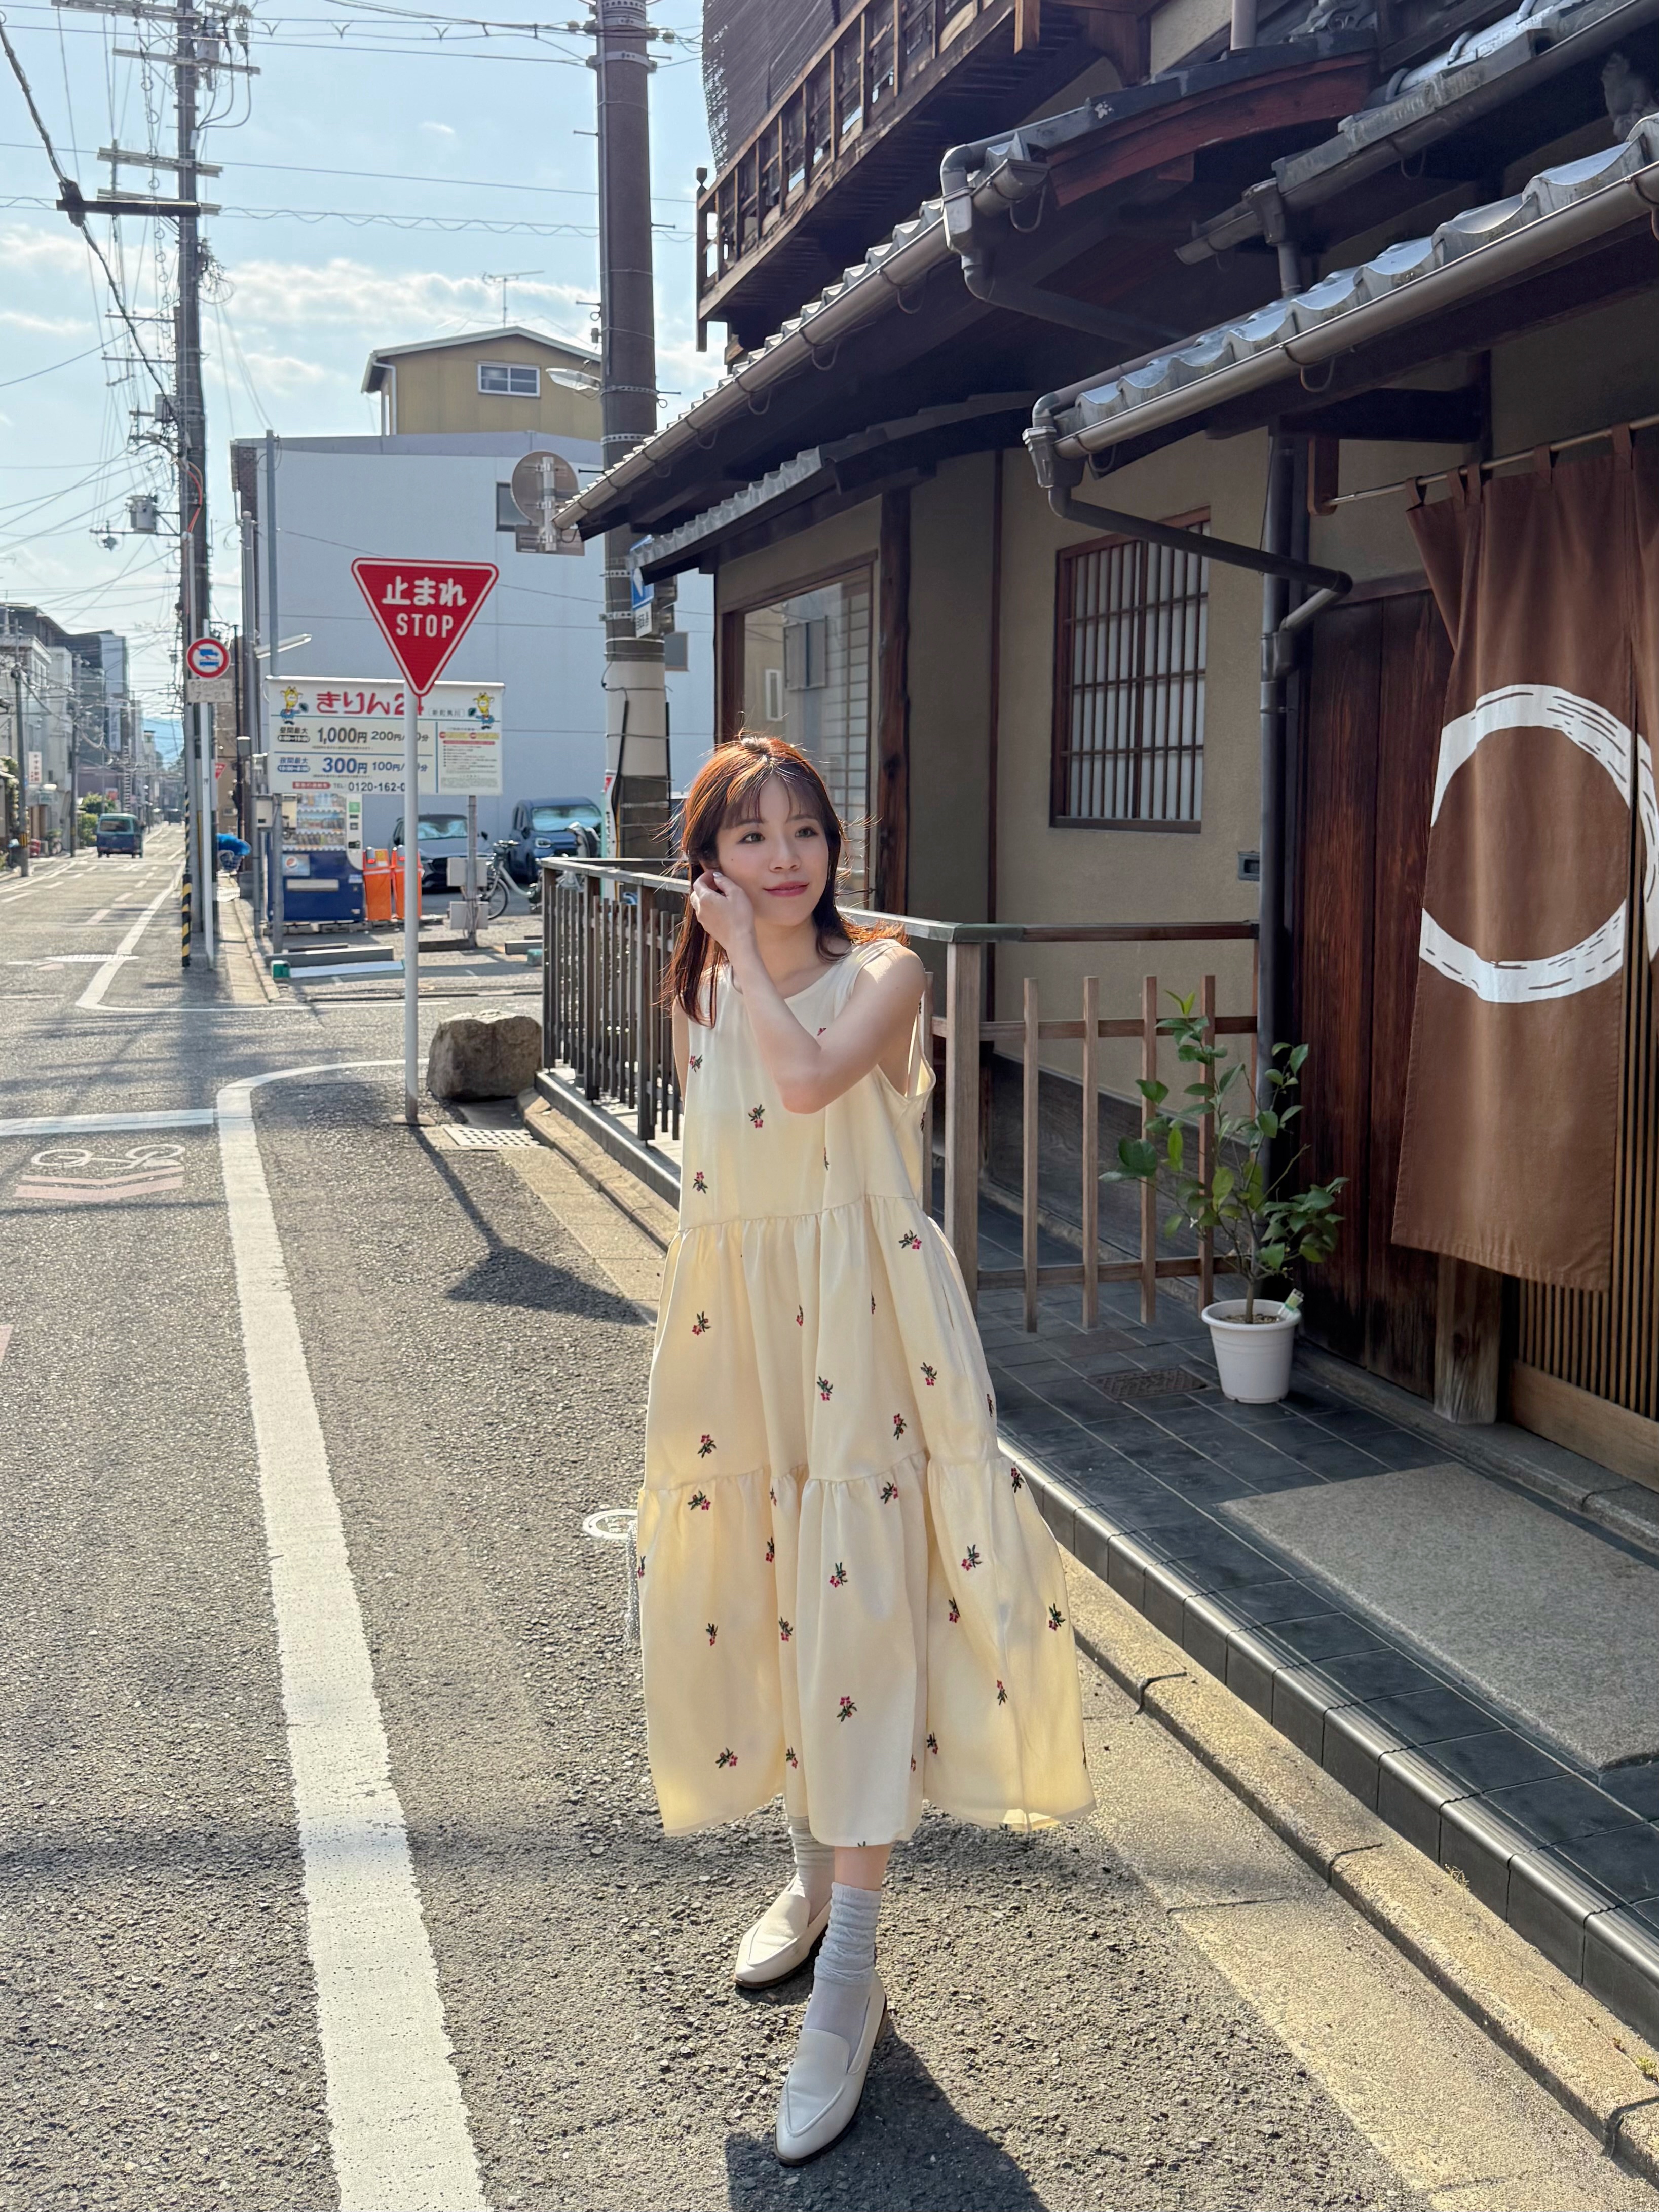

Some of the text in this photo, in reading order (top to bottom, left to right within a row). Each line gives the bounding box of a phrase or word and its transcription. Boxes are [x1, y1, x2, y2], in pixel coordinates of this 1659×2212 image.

[382, 576, 467, 607] 止まれ
[396, 613, 454, 638] STOP
[318, 727, 367, 744] 1,000円
[322, 757, 368, 774] 300円
